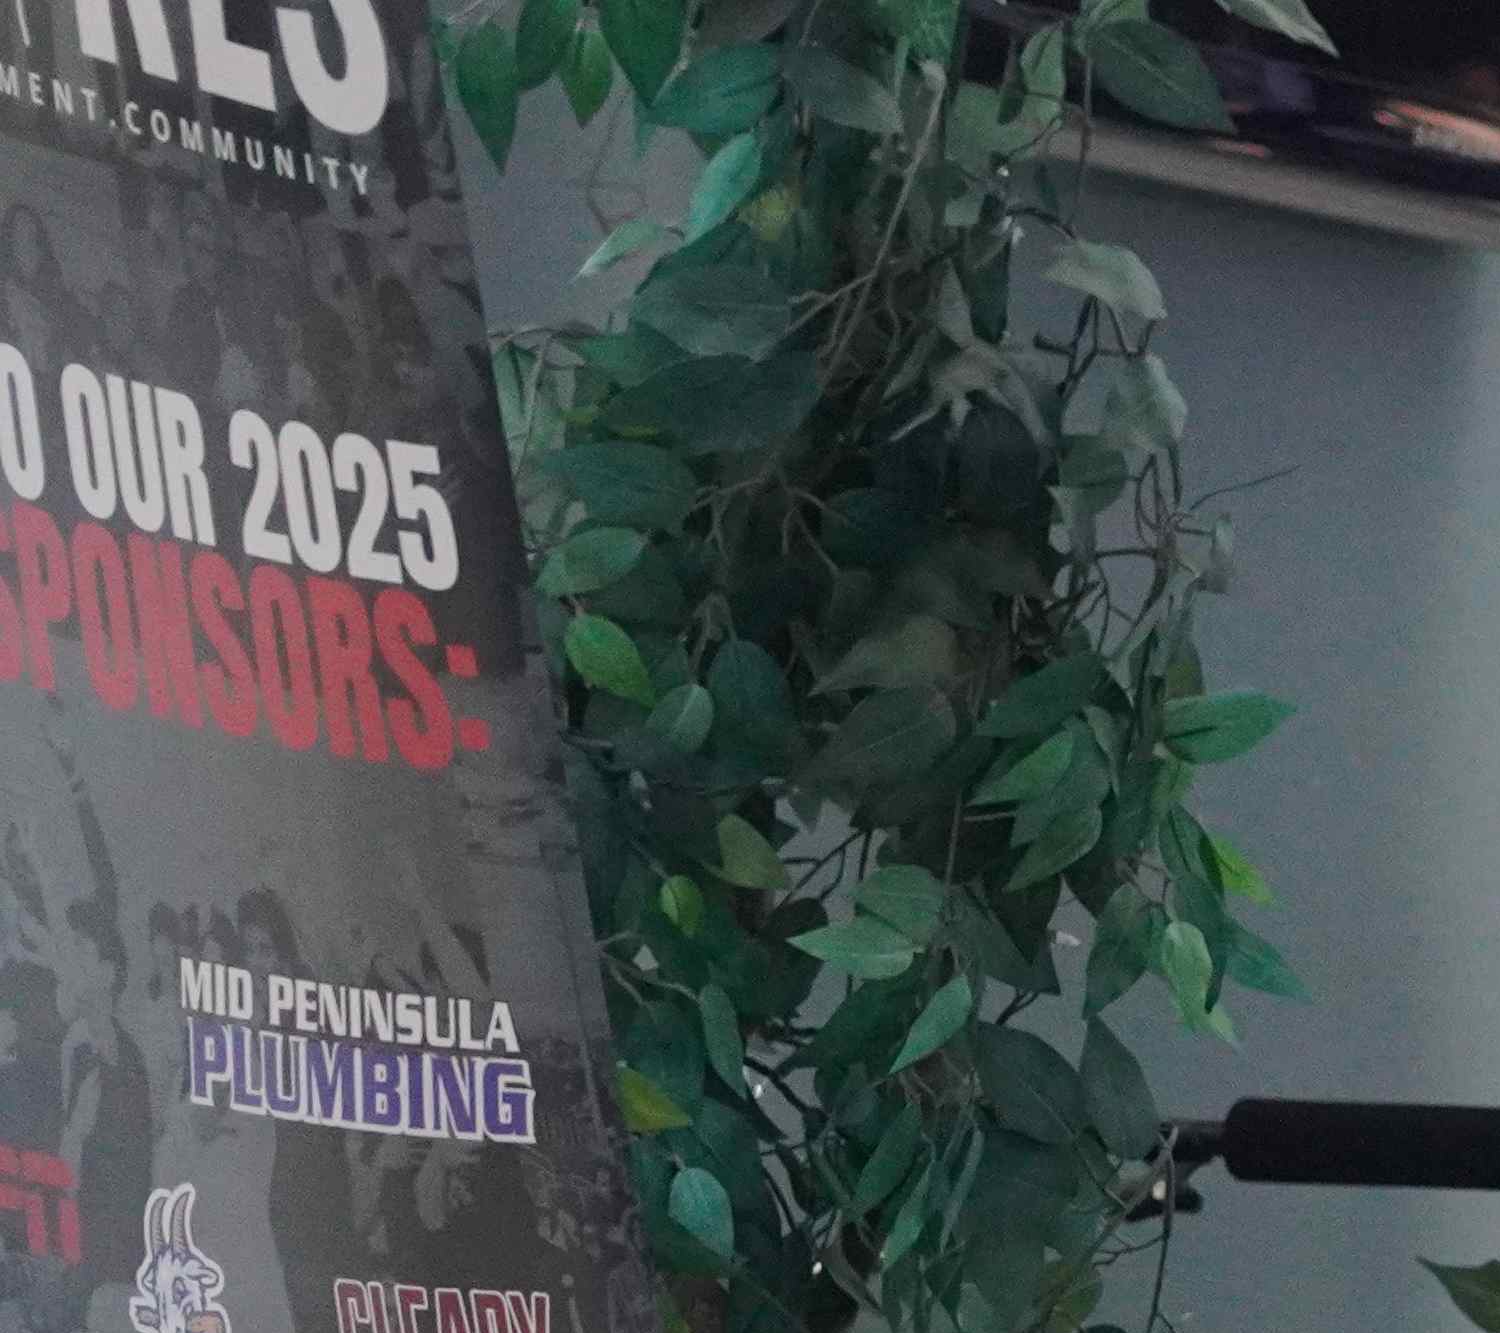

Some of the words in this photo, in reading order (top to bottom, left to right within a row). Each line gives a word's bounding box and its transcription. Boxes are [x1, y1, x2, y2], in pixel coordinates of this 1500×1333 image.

[60, 363, 216, 547] OUR
[228, 408, 459, 591] 2025
[180, 957, 253, 1021] MID
[267, 974, 521, 1053] PENINSULA
[187, 1016, 536, 1145] PLUMBING
